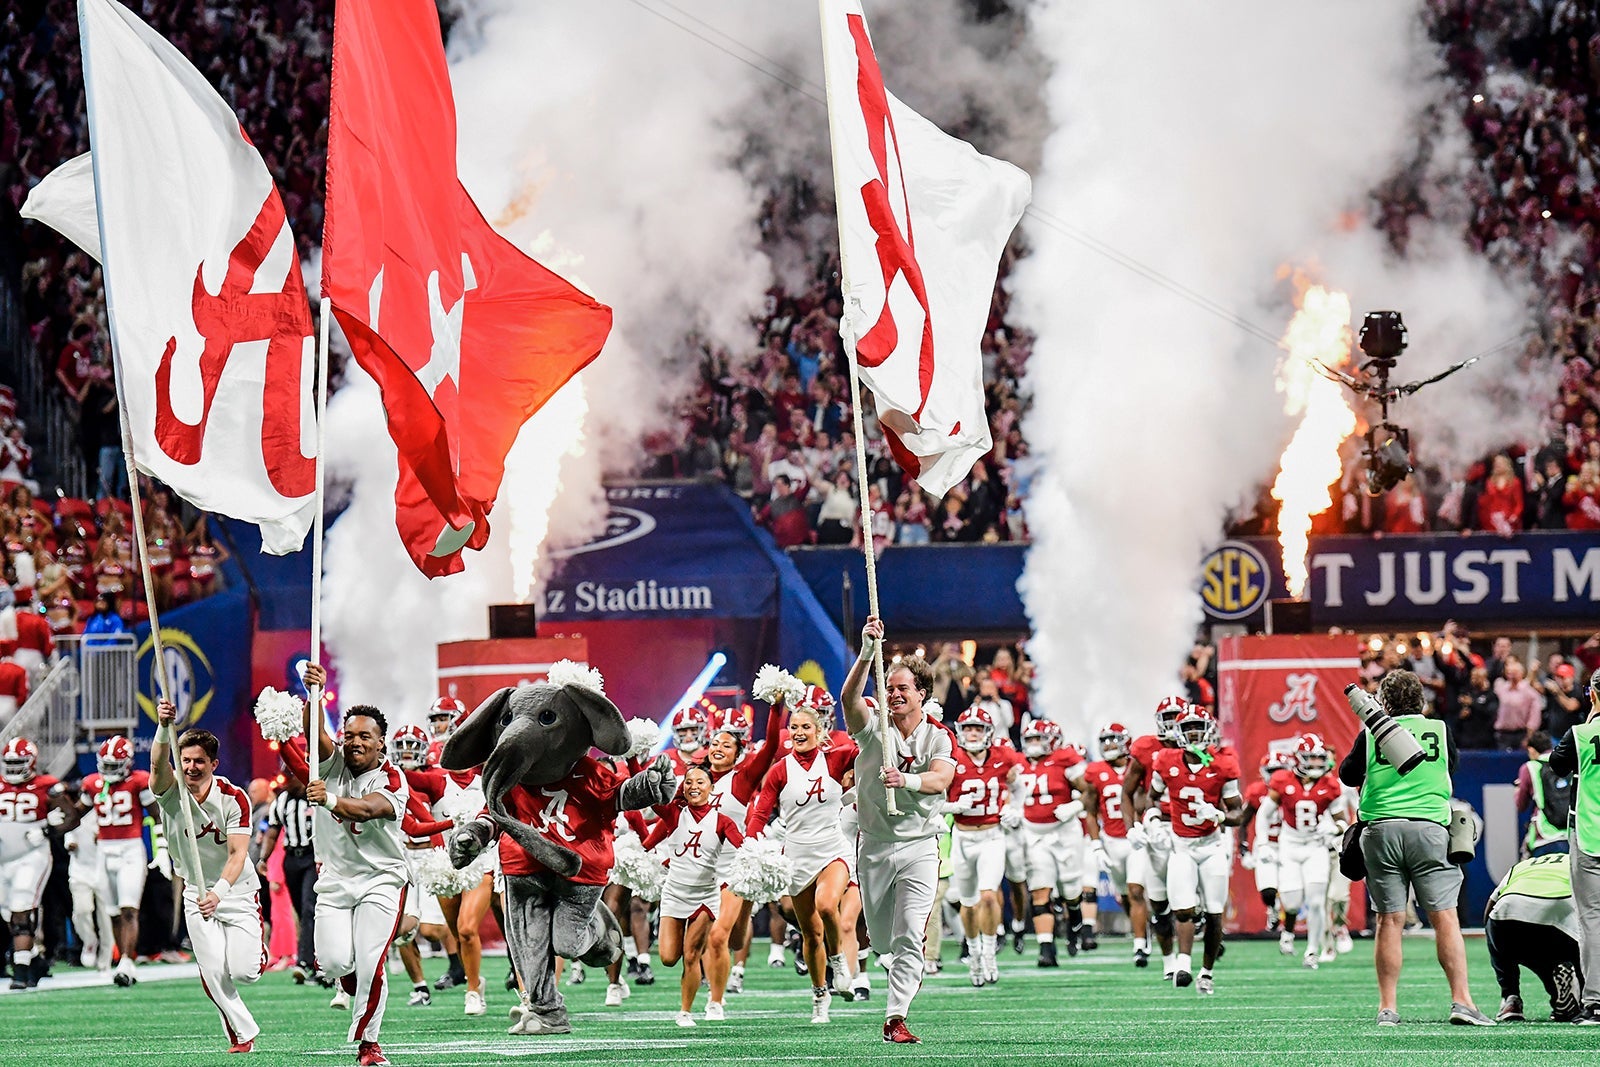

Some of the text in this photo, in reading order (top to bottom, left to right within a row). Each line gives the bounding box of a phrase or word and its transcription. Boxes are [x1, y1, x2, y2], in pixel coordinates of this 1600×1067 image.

[575, 580, 713, 612] Stadium
[1202, 550, 1261, 612] SEC
[1364, 550, 1532, 606] JUST
[1268, 672, 1319, 723] A
[0, 791, 39, 823] 52
[94, 790, 134, 827] 32
[795, 776, 827, 807] A
[960, 776, 1001, 817] 21
[1179, 786, 1206, 827] 3
[530, 786, 577, 842] A
[674, 829, 703, 859] A
